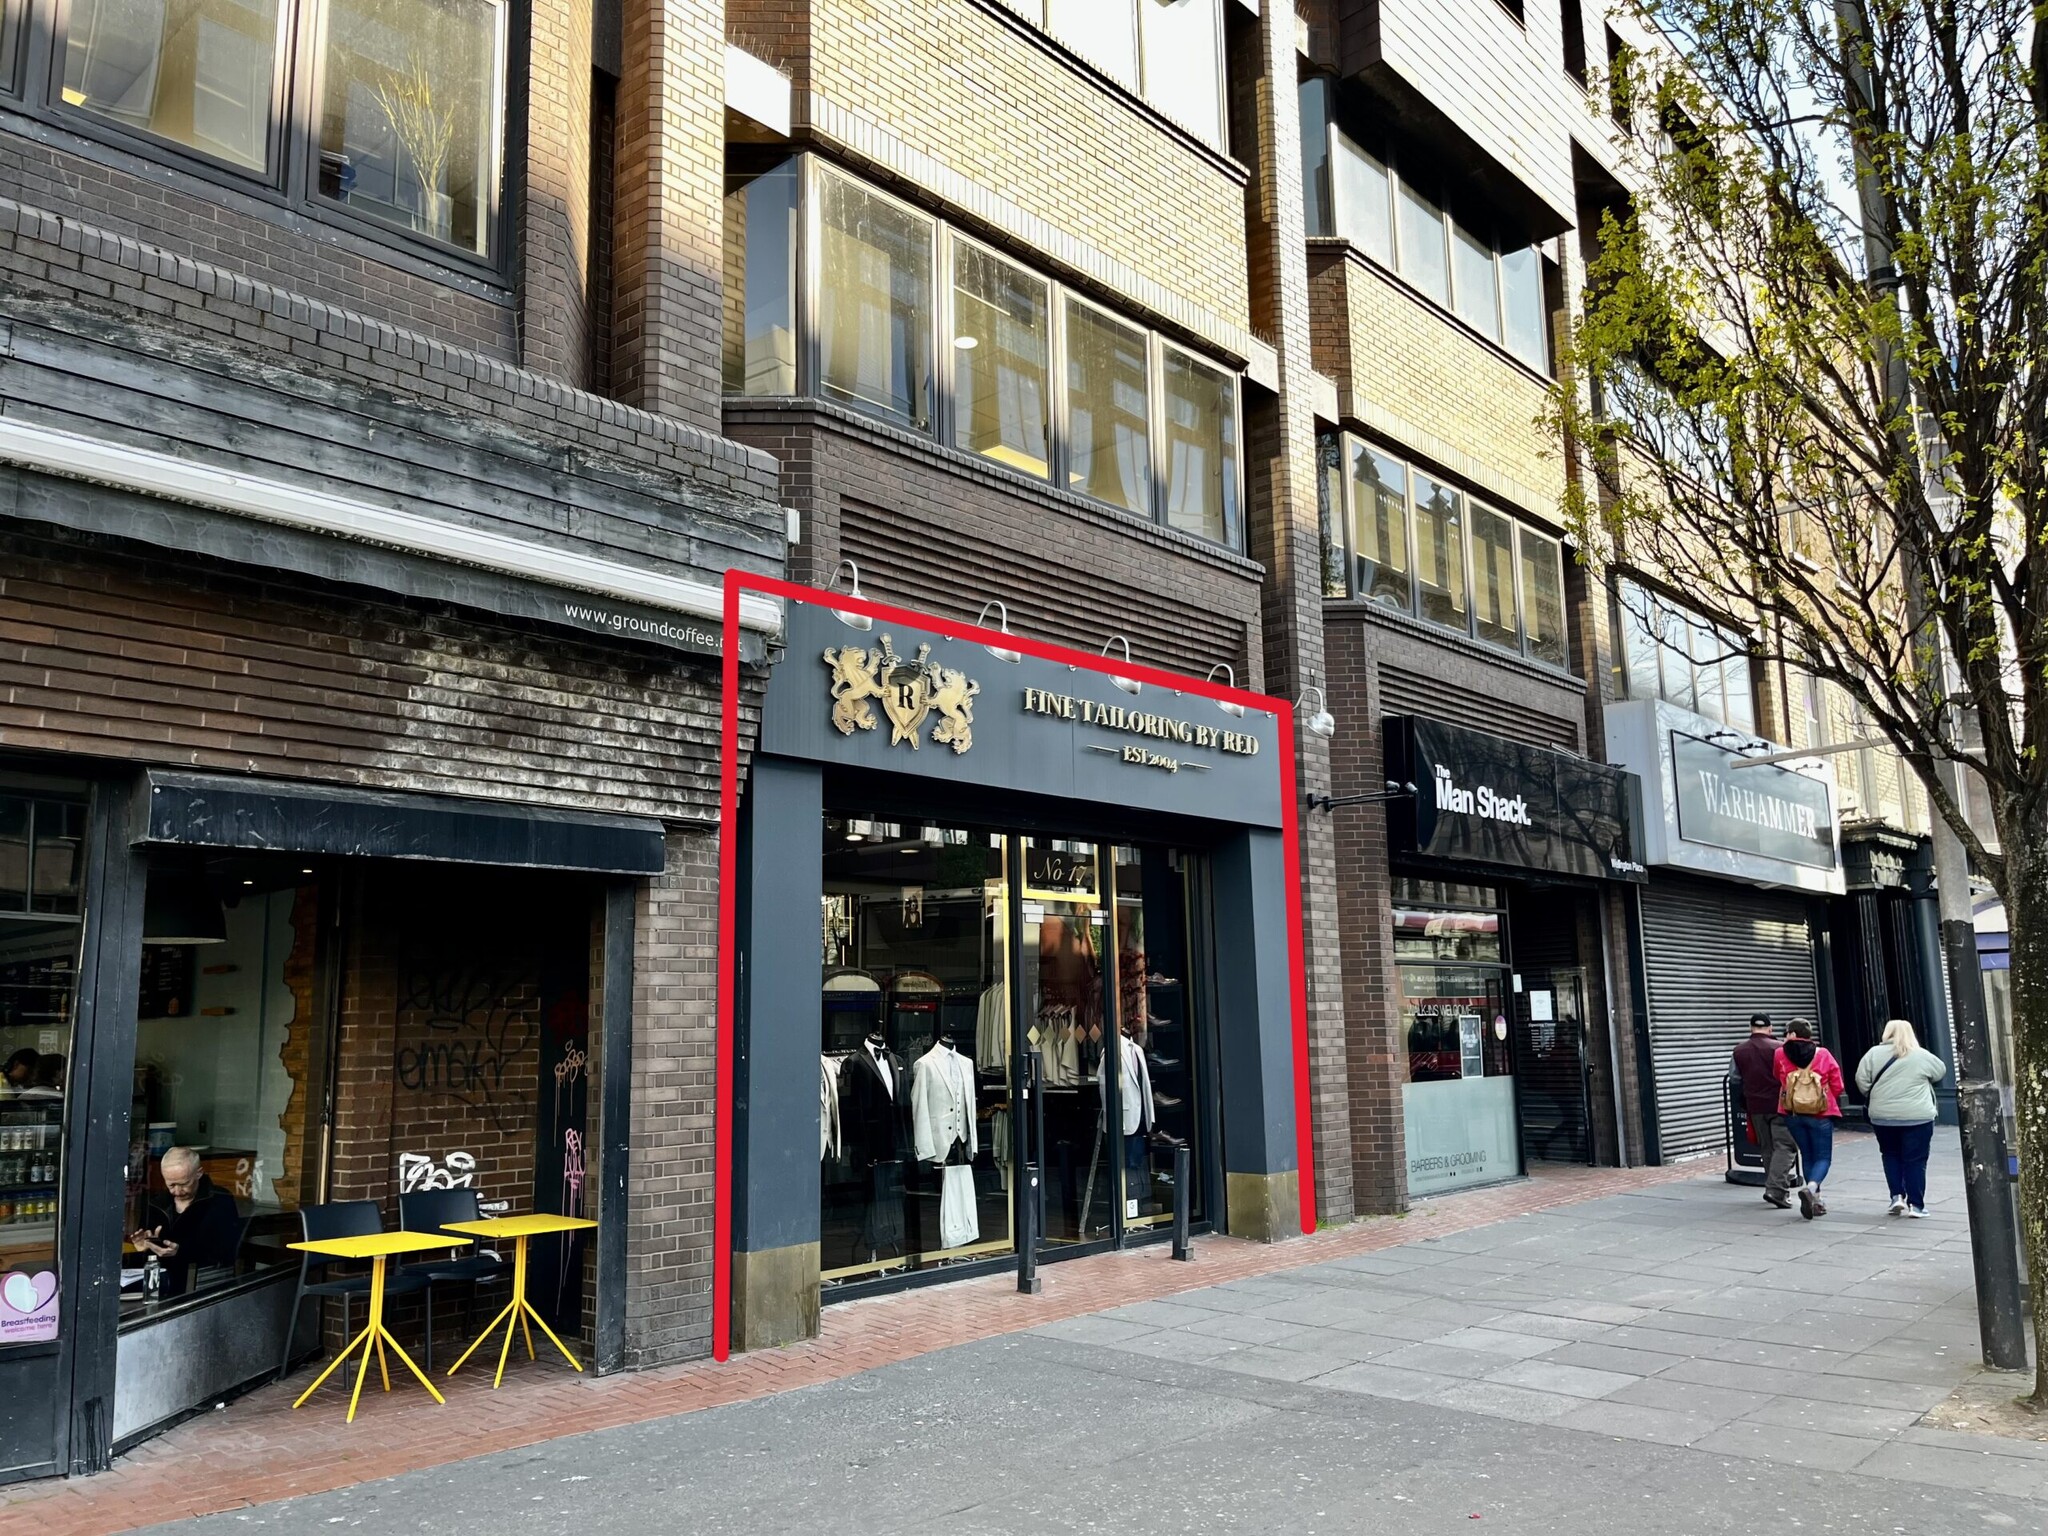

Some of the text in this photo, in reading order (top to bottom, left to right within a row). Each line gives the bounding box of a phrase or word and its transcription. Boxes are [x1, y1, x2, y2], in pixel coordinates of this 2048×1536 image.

[564, 603, 743, 652] www.groundcoffee.t
[896, 683, 915, 710] R
[1023, 687, 1260, 756] FINE TAILORING BY RED
[1122, 745, 1179, 773] EST 2004
[1434, 763, 1450, 779] The
[1435, 777, 1532, 826] Man Shack.
[1698, 769, 1818, 839] WARHAMMER
[1034, 857, 1087, 886] No 17
[1408, 1004, 1472, 1016] WALK-INS WELCOME
[1410, 1156, 1444, 1173] BARBERS
[1444, 1155, 1450, 1168] &
[1450, 1150, 1487, 1167] GROOMING
[1, 1315, 57, 1328] Breastfeeding
[4, 1324, 36, 1334] welcome
